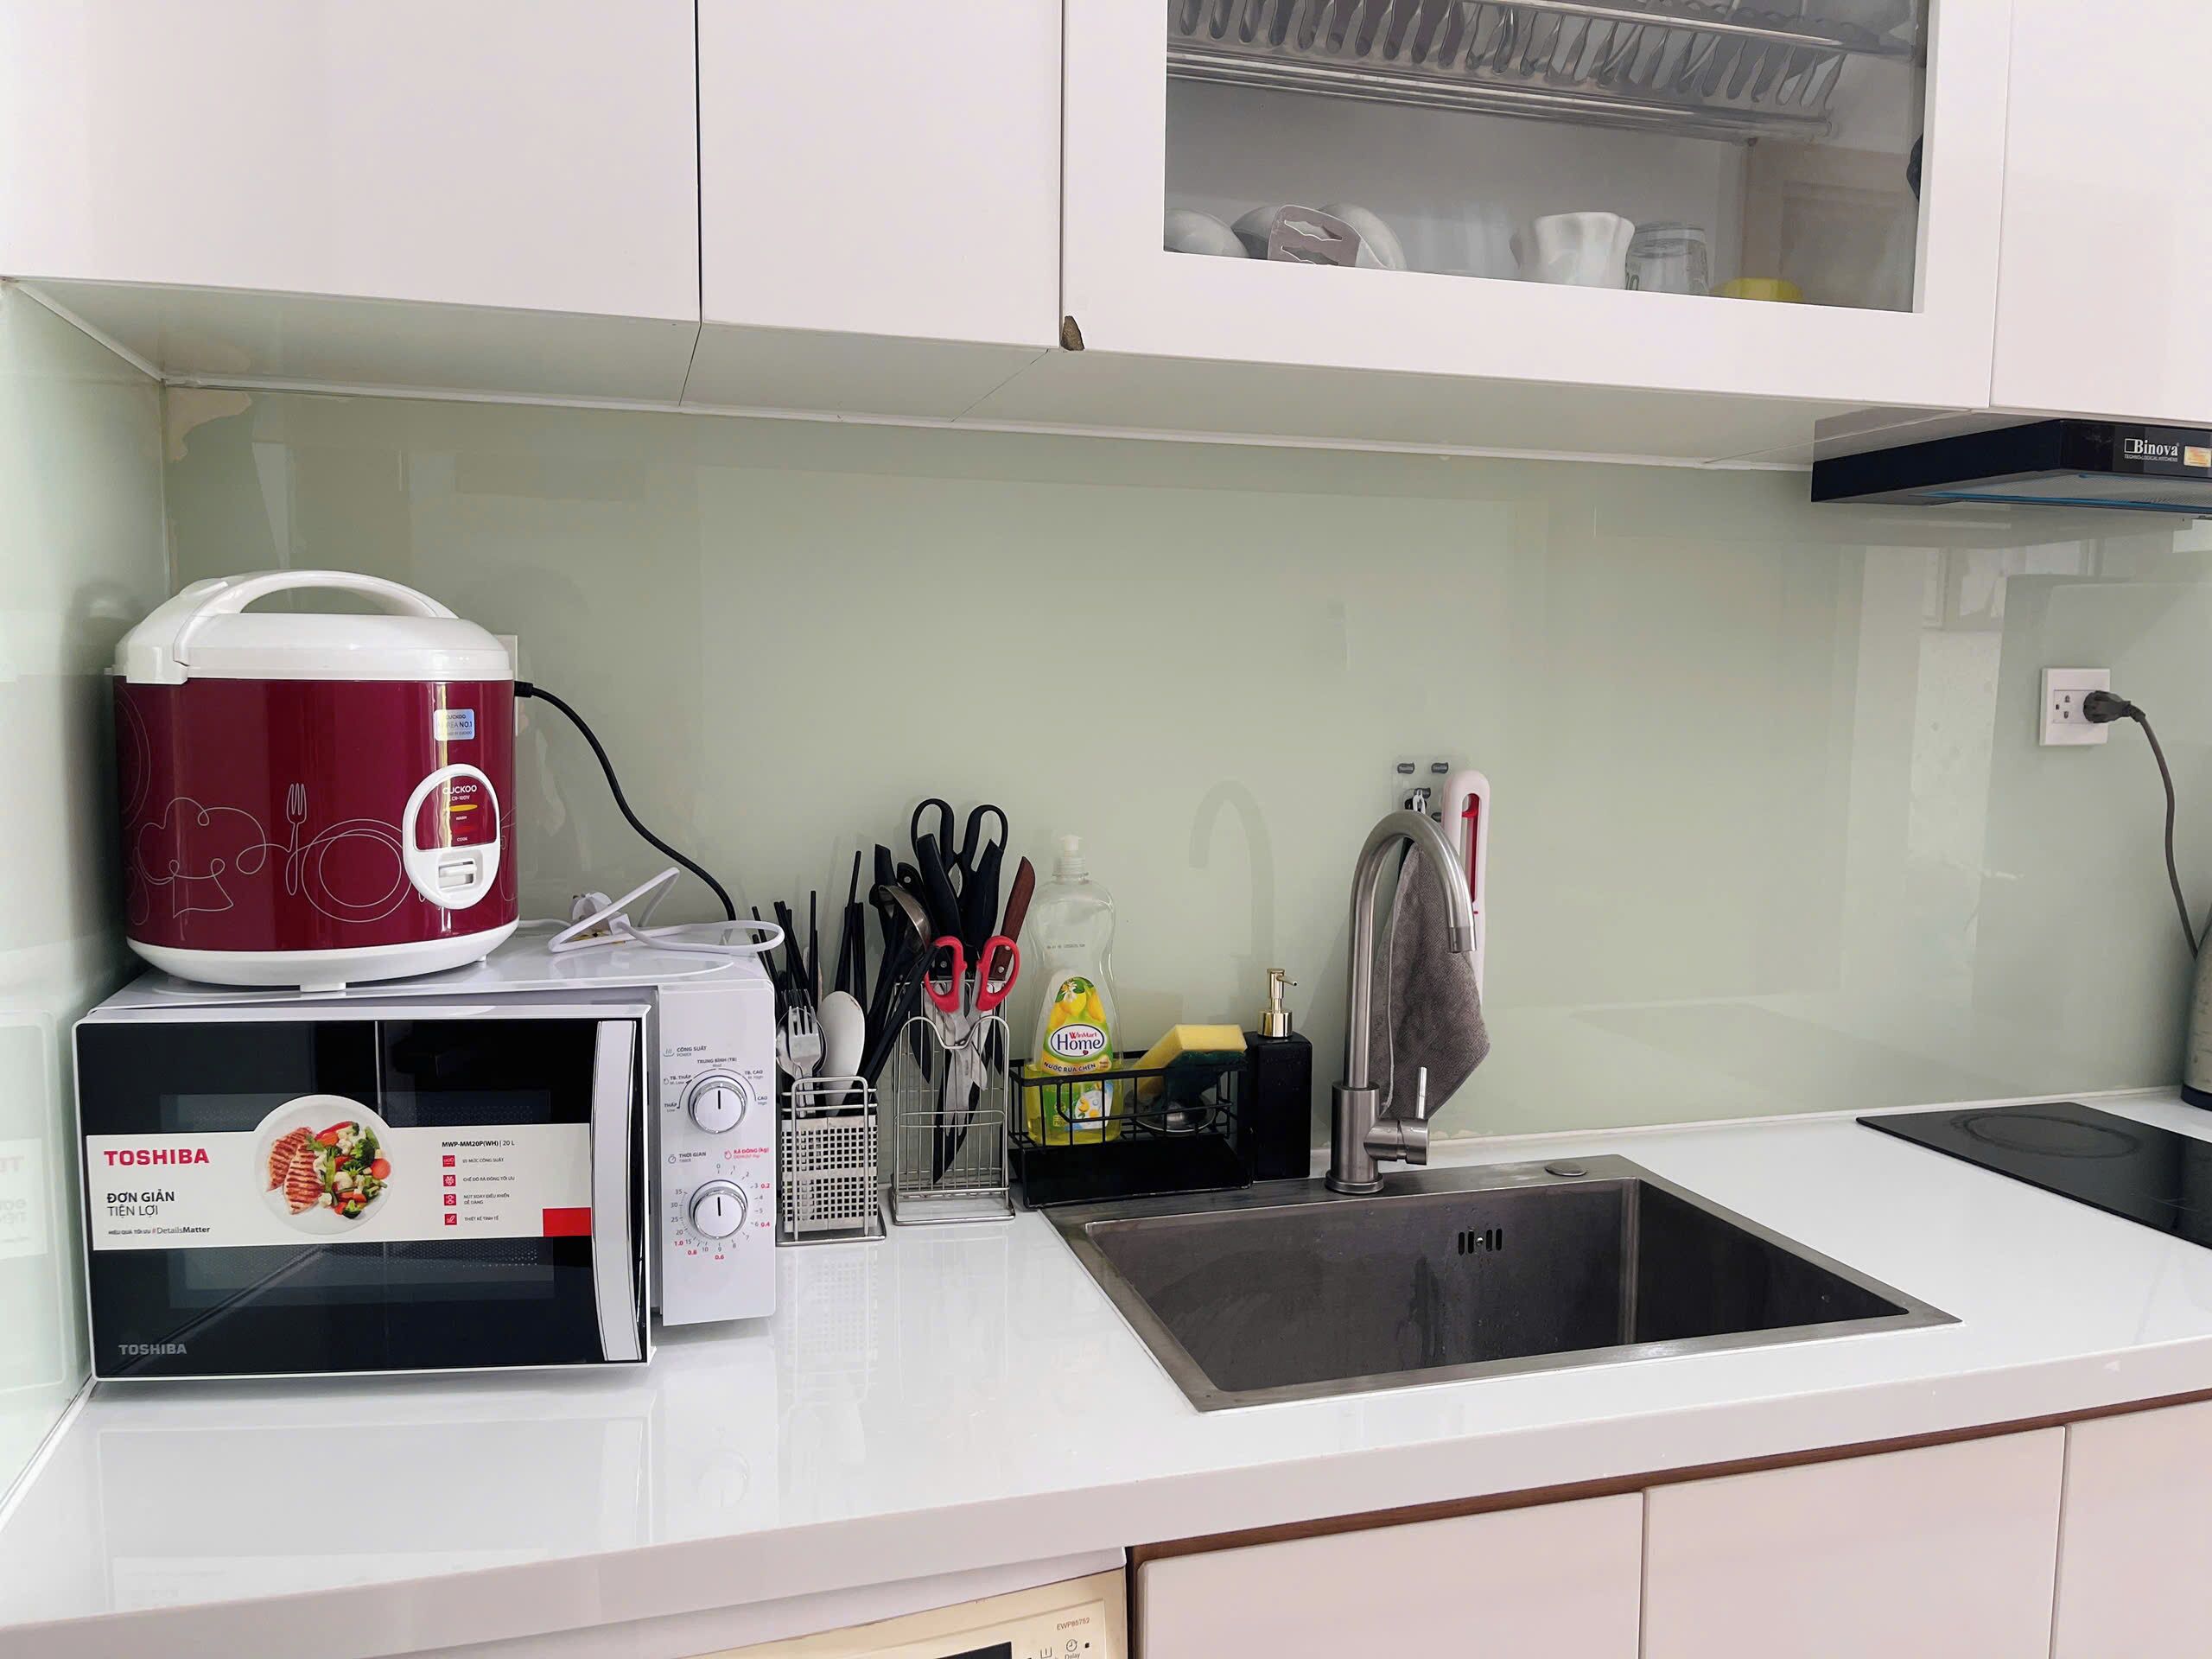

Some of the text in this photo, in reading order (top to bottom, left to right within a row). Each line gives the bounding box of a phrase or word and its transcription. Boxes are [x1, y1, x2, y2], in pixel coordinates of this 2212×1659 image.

[2134, 439, 2178, 456] Binova
[442, 785, 478, 794] CUCKOO
[1057, 1033, 1101, 1051] Home
[1069, 1031, 1097, 1039] WinMart
[104, 1148, 210, 1166] TOSHIBA
[106, 1189, 175, 1204] ĐƠN GIẢN
[107, 1204, 158, 1218] TIỆN LỢI
[118, 1343, 188, 1356] TOSHIBA
